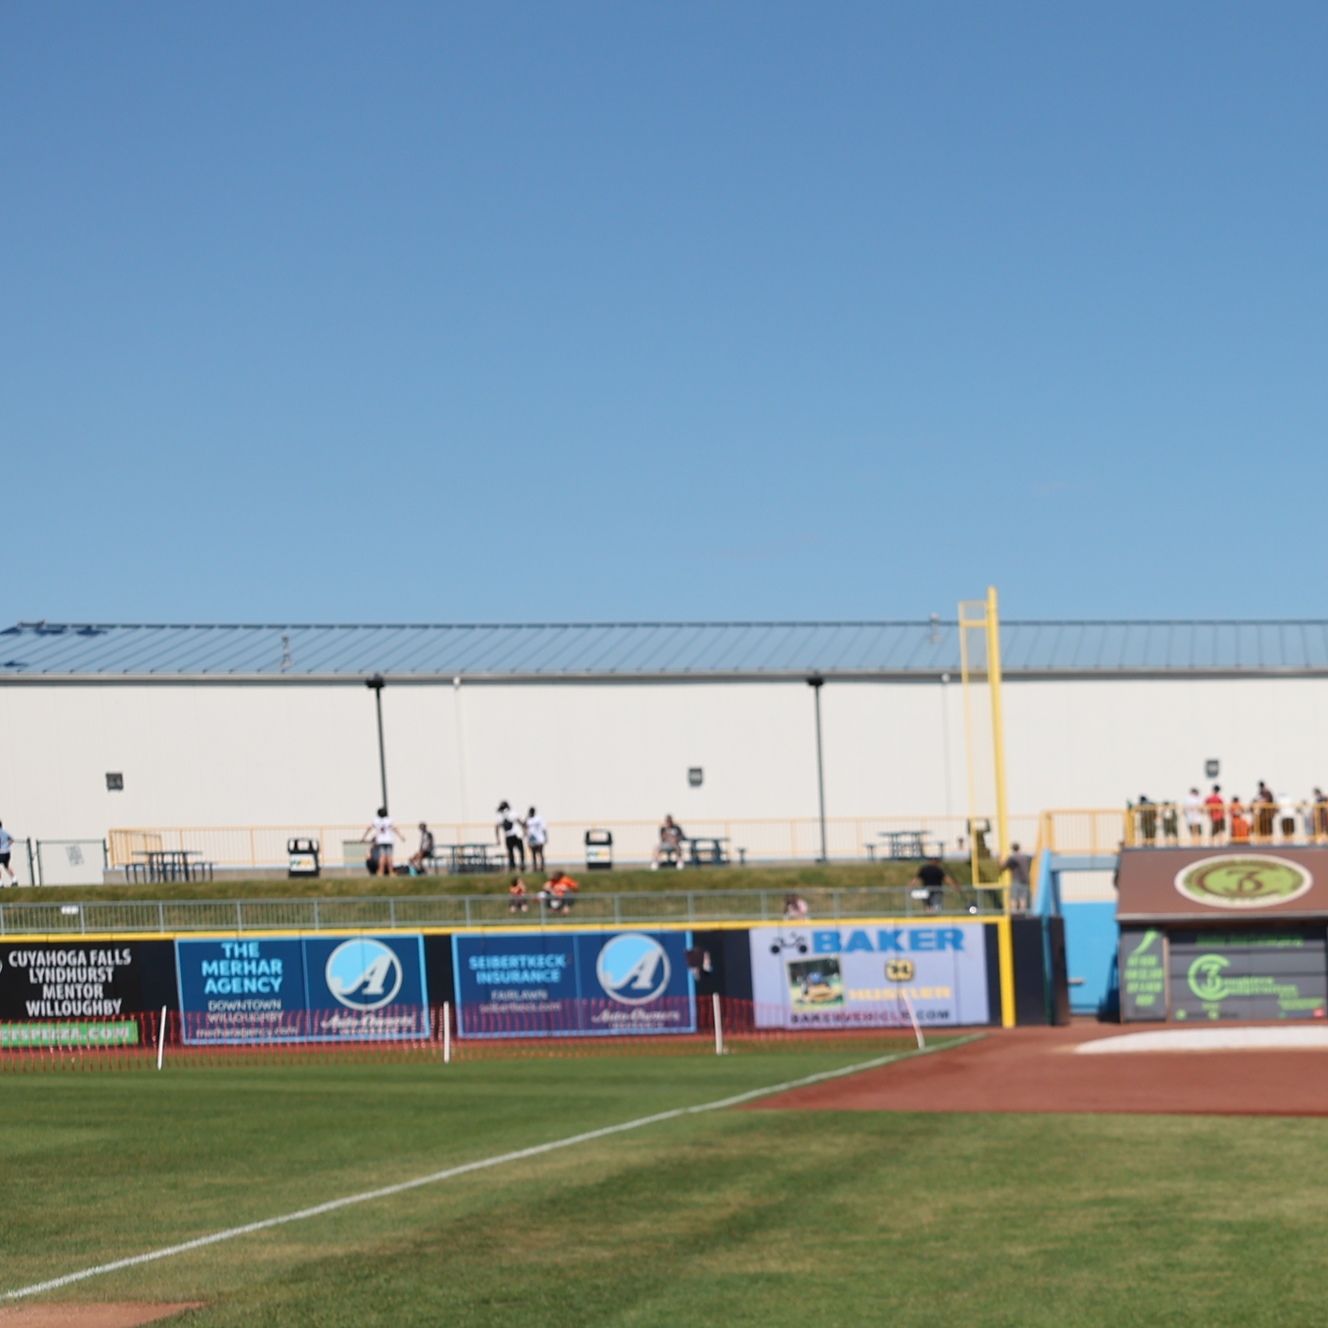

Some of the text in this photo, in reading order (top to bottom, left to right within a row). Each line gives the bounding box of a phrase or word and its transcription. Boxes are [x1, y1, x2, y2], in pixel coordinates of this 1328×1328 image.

[812, 927, 965, 953] BAKER
[8, 948, 132, 967] CUYAHOGA FALLS
[221, 942, 260, 958] THE
[29, 966, 114, 984] LYNDHURST
[201, 958, 283, 976] MERHAR
[476, 968, 562, 984] INSURANCE
[42, 983, 104, 1000] MENTOR
[204, 976, 283, 994] AGENCY
[25, 998, 122, 1017] WILLOUGHBY
[208, 999, 281, 1012] DOWNTOWN
